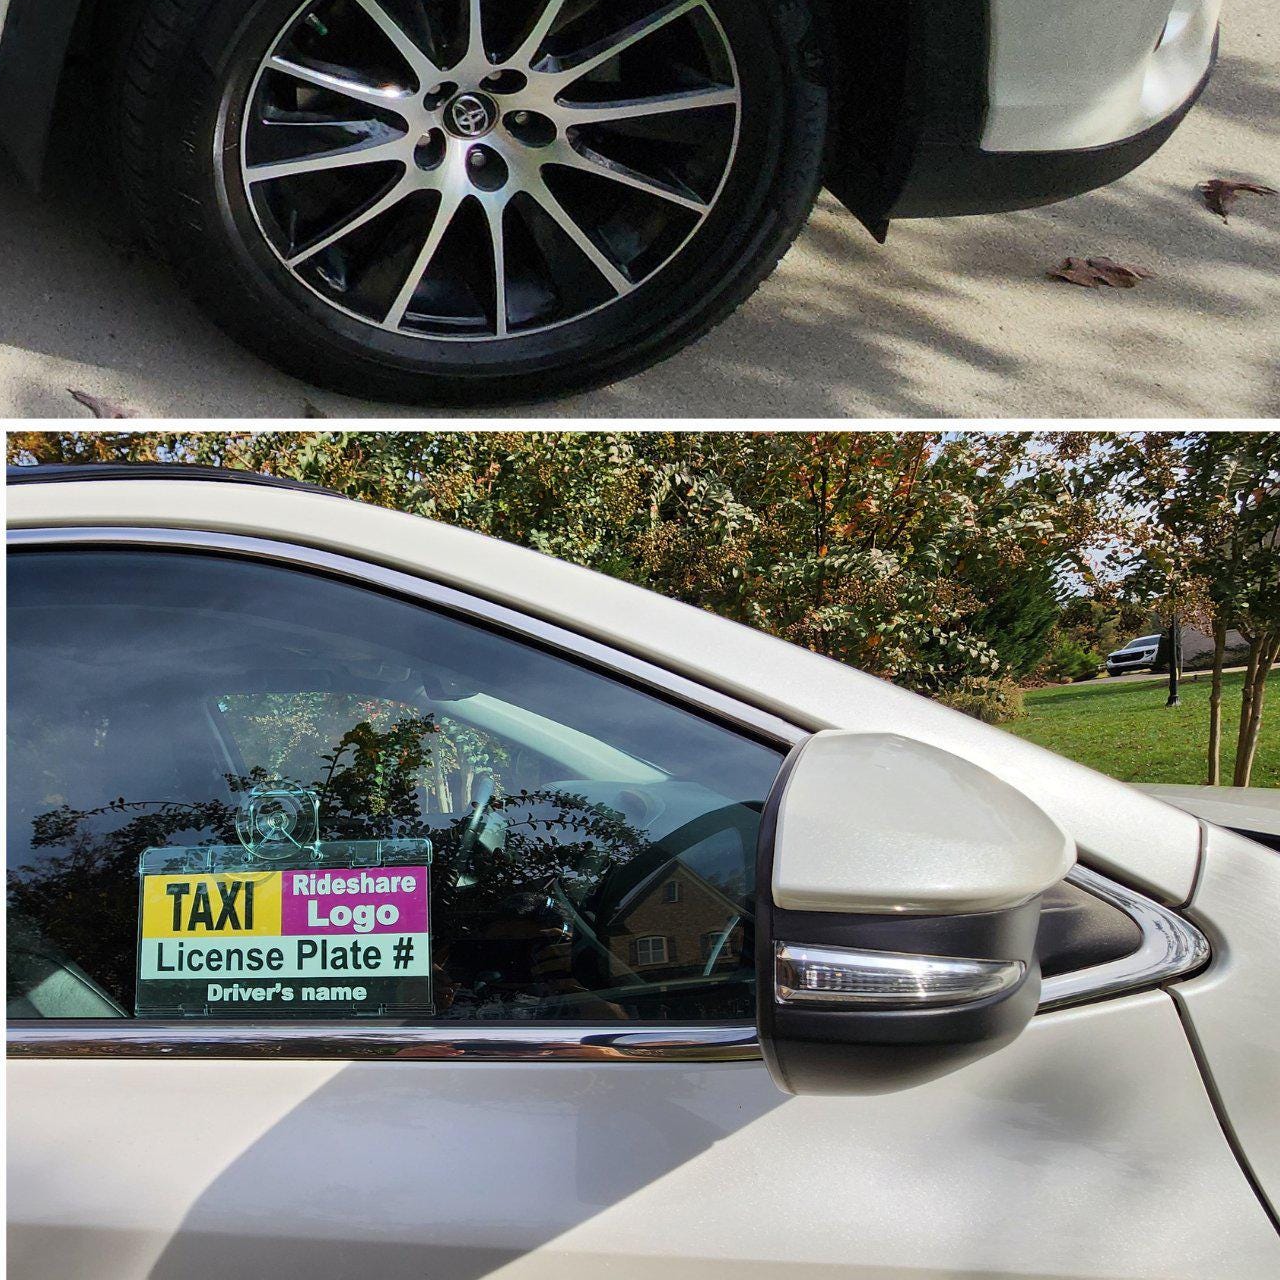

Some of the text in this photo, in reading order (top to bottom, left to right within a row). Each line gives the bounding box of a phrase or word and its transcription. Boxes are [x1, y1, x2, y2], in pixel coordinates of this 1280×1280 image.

[292, 872, 416, 897] Rideshare
[166, 880, 255, 932] TAXI
[306, 899, 400, 934] Logo
[156, 936, 415, 972] License Plate #
[207, 983, 368, 1003] Driver's name
